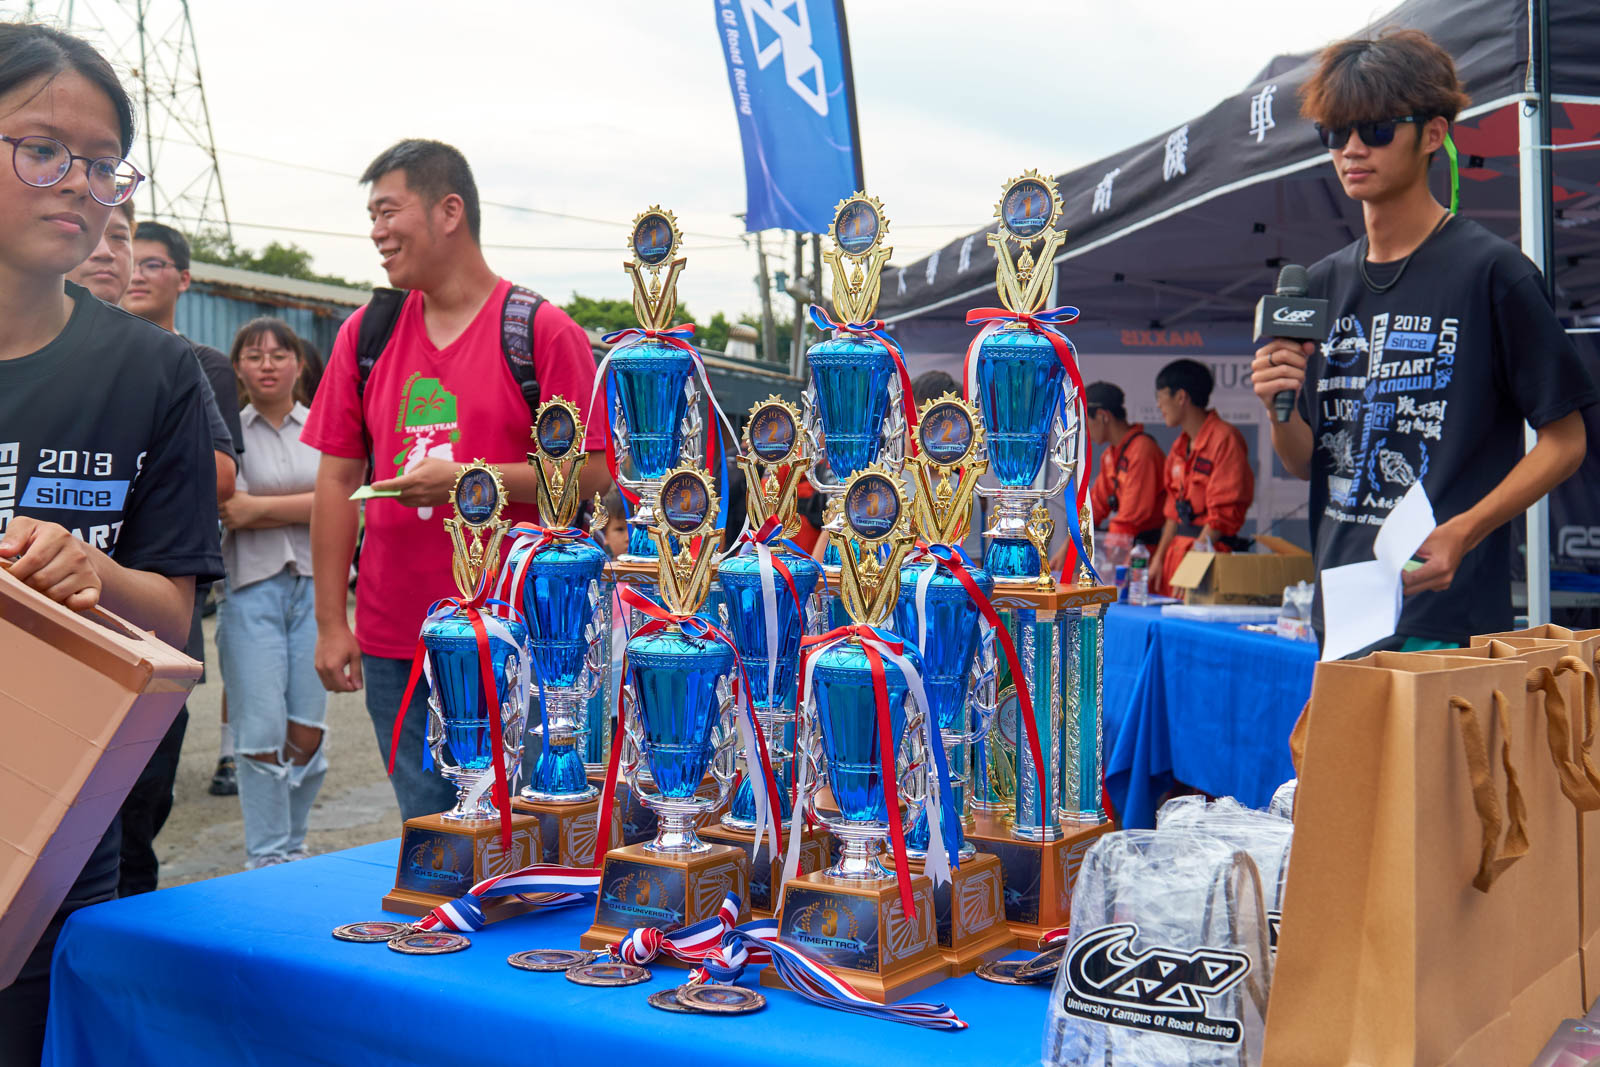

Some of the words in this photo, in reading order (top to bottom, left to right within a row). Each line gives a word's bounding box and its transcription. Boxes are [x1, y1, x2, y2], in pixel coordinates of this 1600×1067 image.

[726, 28, 745, 66] Road
[733, 67, 752, 116] Racing
[1393, 314, 1432, 332] 2013
[1391, 335, 1428, 350] since
[1437, 318, 1459, 366] UCRR
[1380, 357, 1436, 379] START
[404, 424, 433, 434] TAIPEI
[434, 421, 457, 431] TEAM
[552, 420, 561, 440] 2
[767, 421, 779, 443] 2
[941, 420, 953, 442] 2
[37, 448, 113, 476] 2013
[35, 482, 112, 507] since
[680, 489, 692, 513] 3
[866, 493, 879, 518] 3
[431, 846, 445, 871] 3
[635, 879, 651, 906] 3
[821, 908, 838, 938] 3
[1066, 997, 1110, 1018] University
[1111, 1007, 1152, 1027] Campus
[1153, 1014, 1166, 1026] Of
[1167, 1017, 1194, 1033] Road
[1195, 1022, 1235, 1039] Racing
